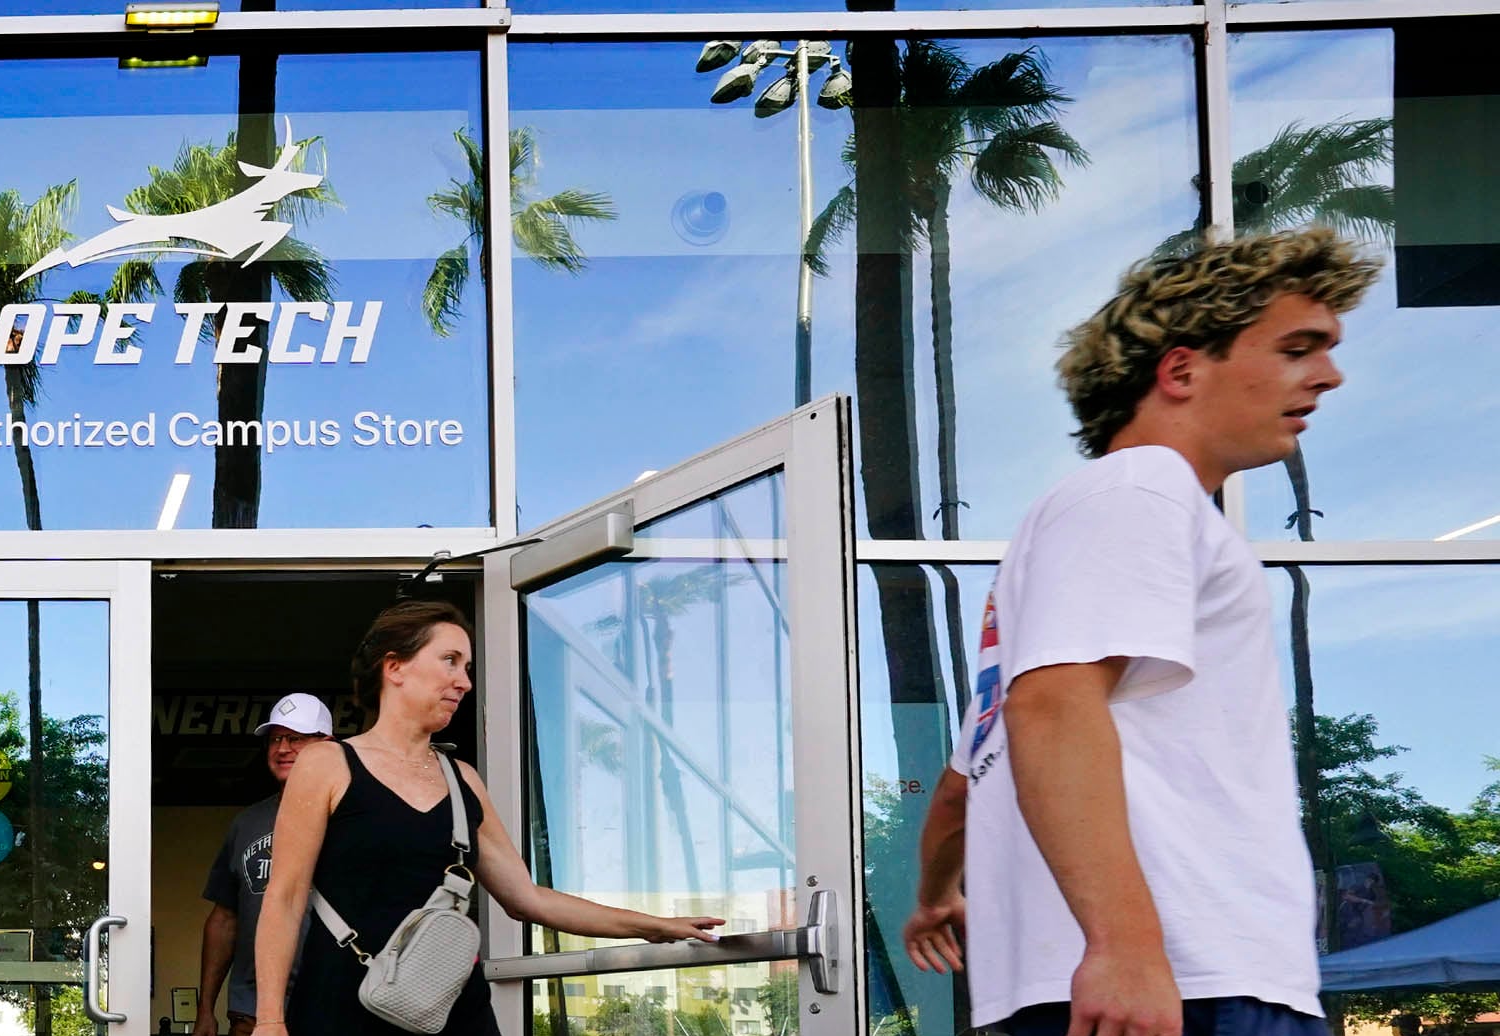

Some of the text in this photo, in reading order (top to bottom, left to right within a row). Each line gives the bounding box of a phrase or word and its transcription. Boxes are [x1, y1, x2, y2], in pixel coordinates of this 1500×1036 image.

[174, 301, 384, 365] TECH
[168, 411, 341, 454] Campus
[353, 410, 464, 447] Store
